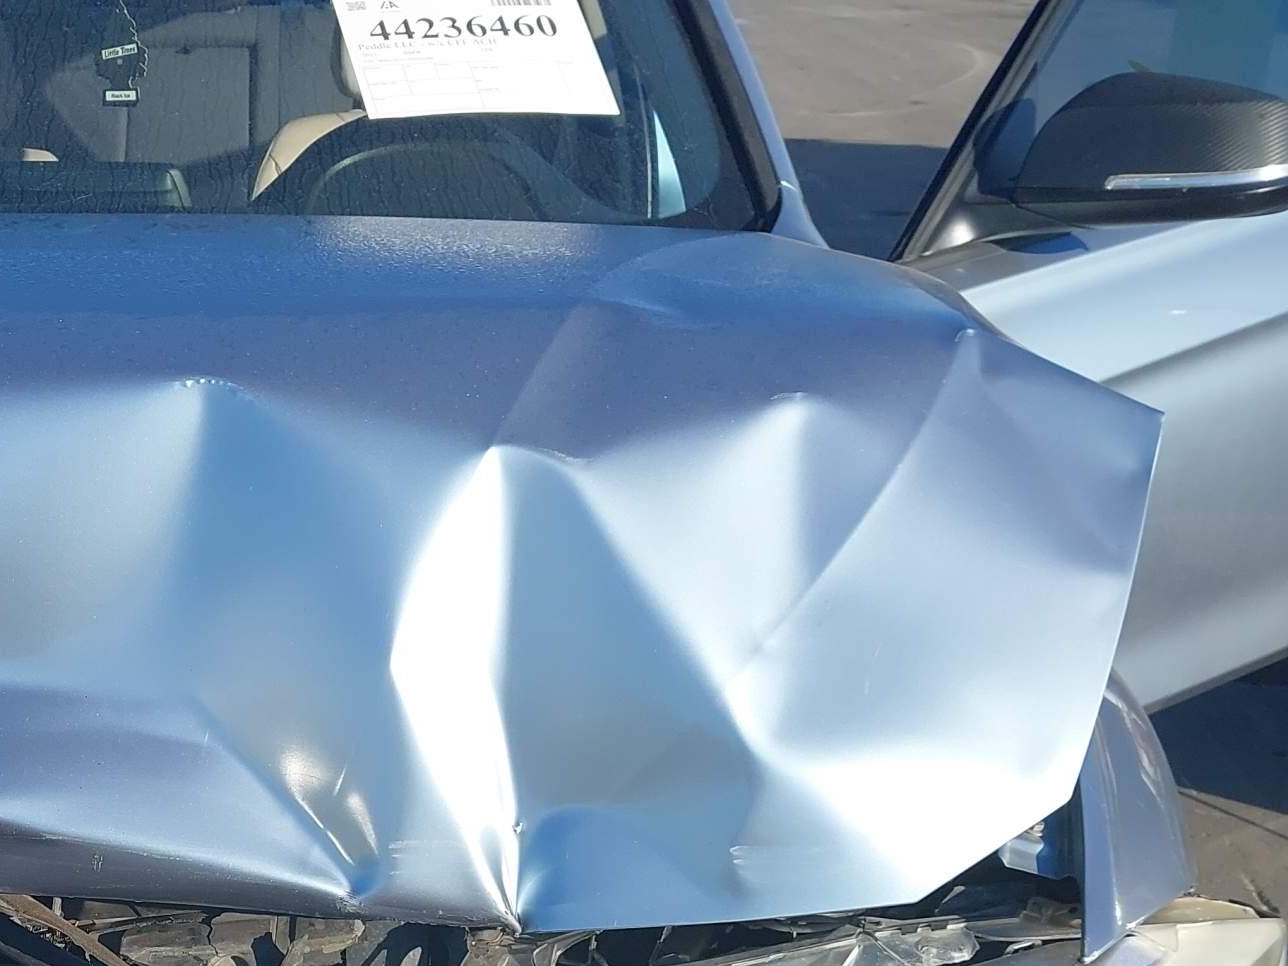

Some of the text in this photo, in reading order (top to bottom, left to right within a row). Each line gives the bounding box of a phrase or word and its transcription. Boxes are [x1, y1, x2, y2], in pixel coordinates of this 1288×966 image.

[369, 15, 558, 41] 44236460
[104, 46, 136, 58] Little Trees
